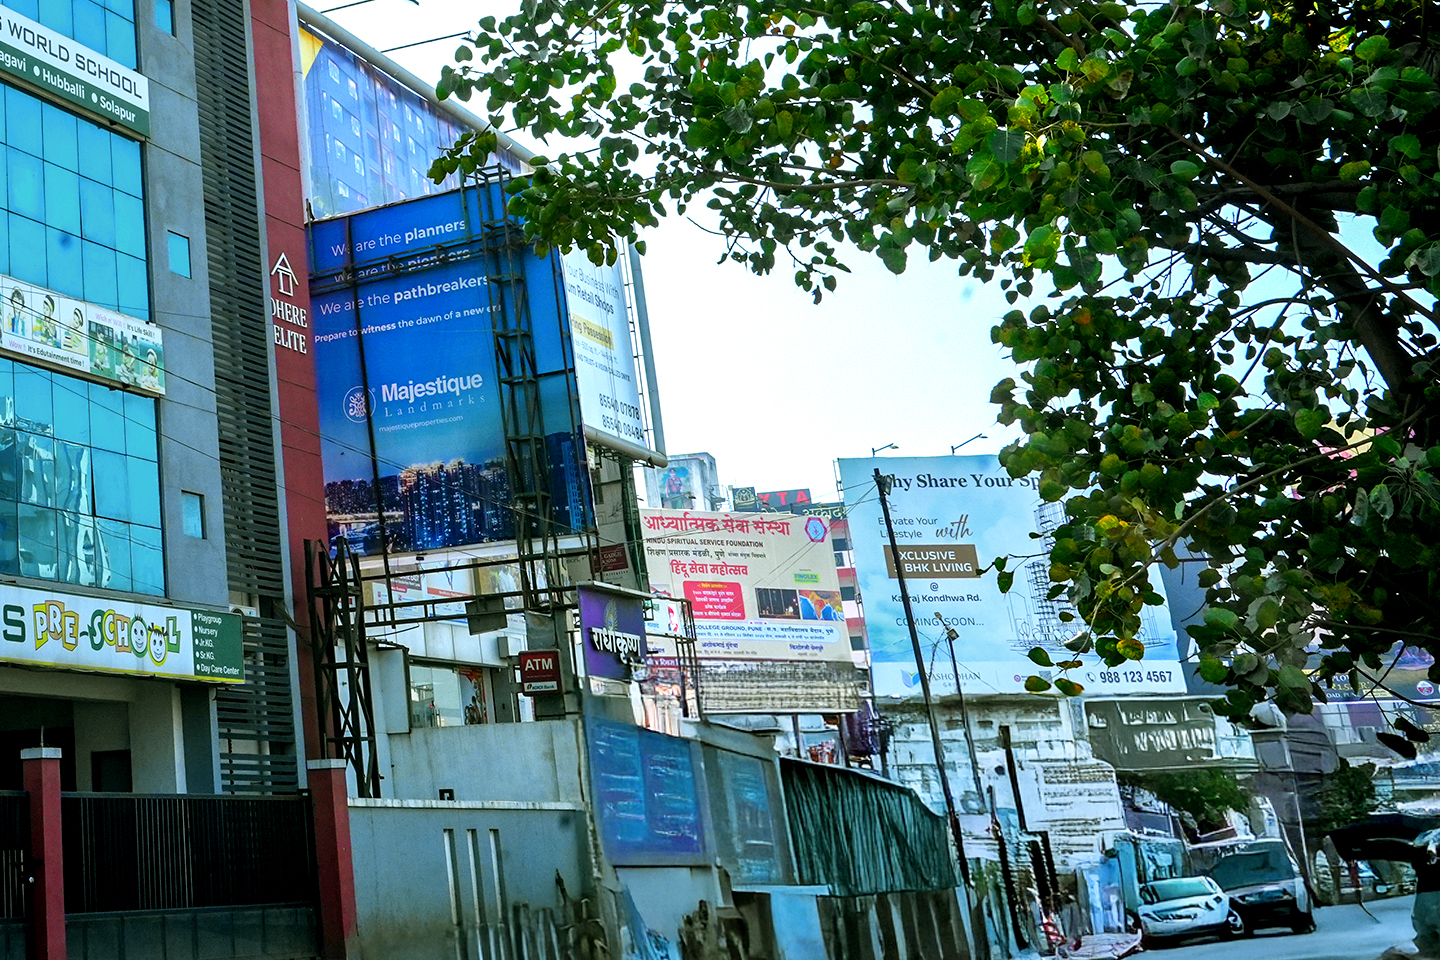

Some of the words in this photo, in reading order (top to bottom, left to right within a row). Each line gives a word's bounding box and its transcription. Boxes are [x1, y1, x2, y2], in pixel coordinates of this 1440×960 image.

[7, 19, 69, 63] WORLD
[75, 54, 143, 99] SCHOOL
[42, 68, 85, 100] Hubballi
[99, 96, 136, 123] Solapur
[355, 240, 376, 253] are
[379, 233, 401, 248] the
[404, 220, 466, 244] planners
[320, 302, 341, 316] We
[367, 292, 391, 307] the
[394, 275, 488, 304] pathbreakers
[314, 330, 347, 344] Prepare
[349, 328, 358, 338] to
[360, 322, 396, 335] witness
[398, 317, 414, 329] the
[416, 314, 442, 326] dawn
[444, 310, 455, 321] of
[463, 307, 484, 317] new
[274, 325, 307, 355] ELITE
[382, 373, 483, 403] Majestique
[385, 395, 485, 417] Landmarks
[379, 414, 464, 433] majestiqueproperties.com
[889, 473, 912, 492] hy
[916, 473, 968, 489] Share
[644, 512, 720, 533] आध्यात्मिक
[722, 514, 750, 534] सेवा
[752, 516, 790, 536] संस्था
[878, 517, 914, 526] Evate
[916, 517, 938, 526] Your
[935, 514, 973, 540] with
[667, 538, 698, 546] SPIRITUAL
[699, 539, 724, 547] SERVICE
[726, 540, 764, 548] FOUNDATION
[880, 530, 922, 539] Lestyle
[896, 551, 956, 561] XCLUSIVE
[670, 559, 689, 578] हिंदू
[689, 560, 708, 574] सेवा
[710, 562, 748, 576] महोत्सव
[904, 562, 930, 573] BHK
[933, 562, 973, 573] LIVING
[892, 594, 921, 604] Karaj
[922, 594, 965, 603] Kondhwa
[967, 594, 982, 602] Rd.
[198, 613, 222, 625] Playgroup
[33, 600, 181, 667] PRE-SCHOOL
[198, 626, 218, 637] Nursery
[201, 664, 210, 674] Day
[211, 664, 222, 674] Care
[223, 666, 239, 675] Center
[525, 658, 553, 671] ATM
[1099, 671, 1120, 684] 988
[1122, 670, 1144, 683] 123
[1146, 670, 1173, 683] 4567
